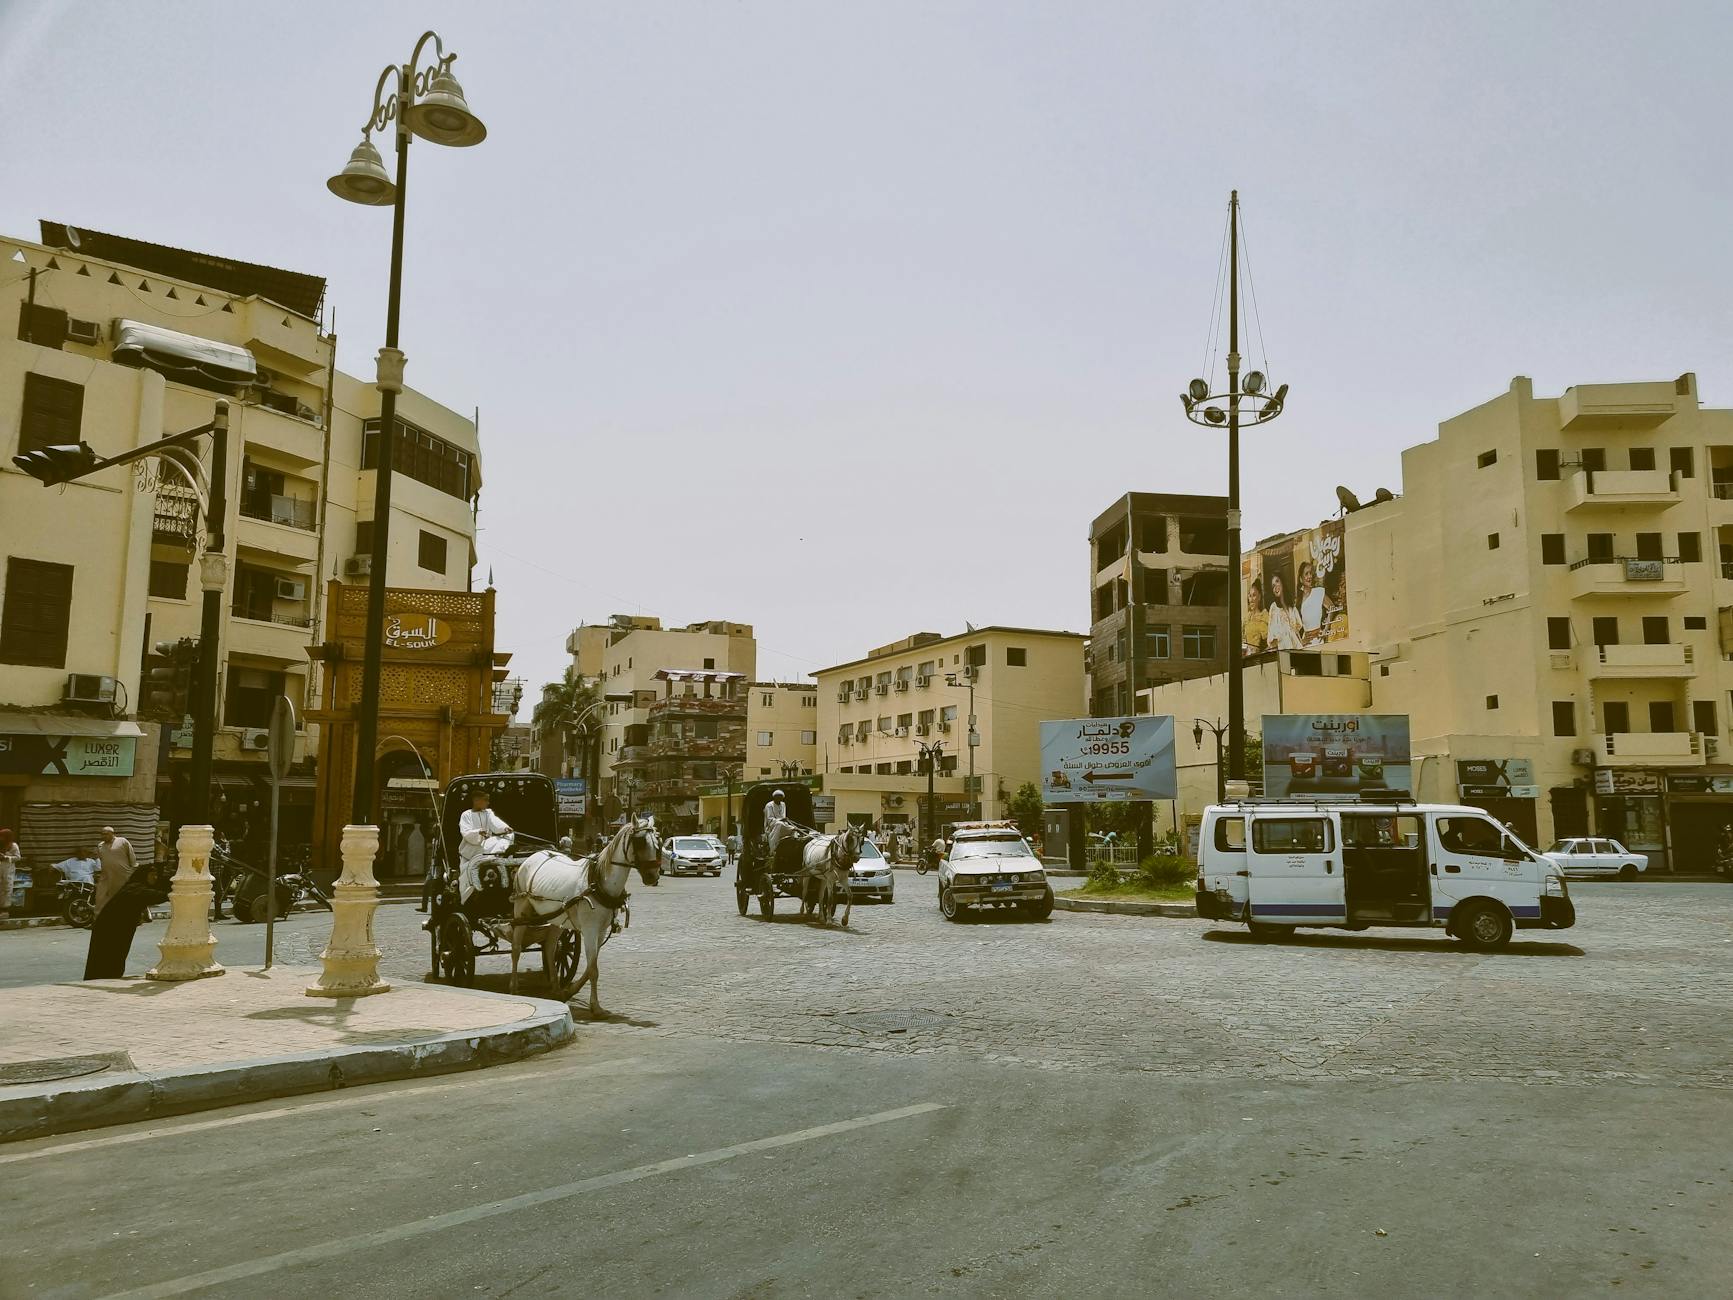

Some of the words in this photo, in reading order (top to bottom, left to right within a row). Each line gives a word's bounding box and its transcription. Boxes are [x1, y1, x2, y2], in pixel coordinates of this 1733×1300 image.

[385, 616, 438, 639] السوق
[385, 638, 437, 648] EL-SOUK
[1077, 723, 1120, 739] دلمار
[85, 743, 119, 755] LUXOR
[1089, 741, 1130, 755] 19955
